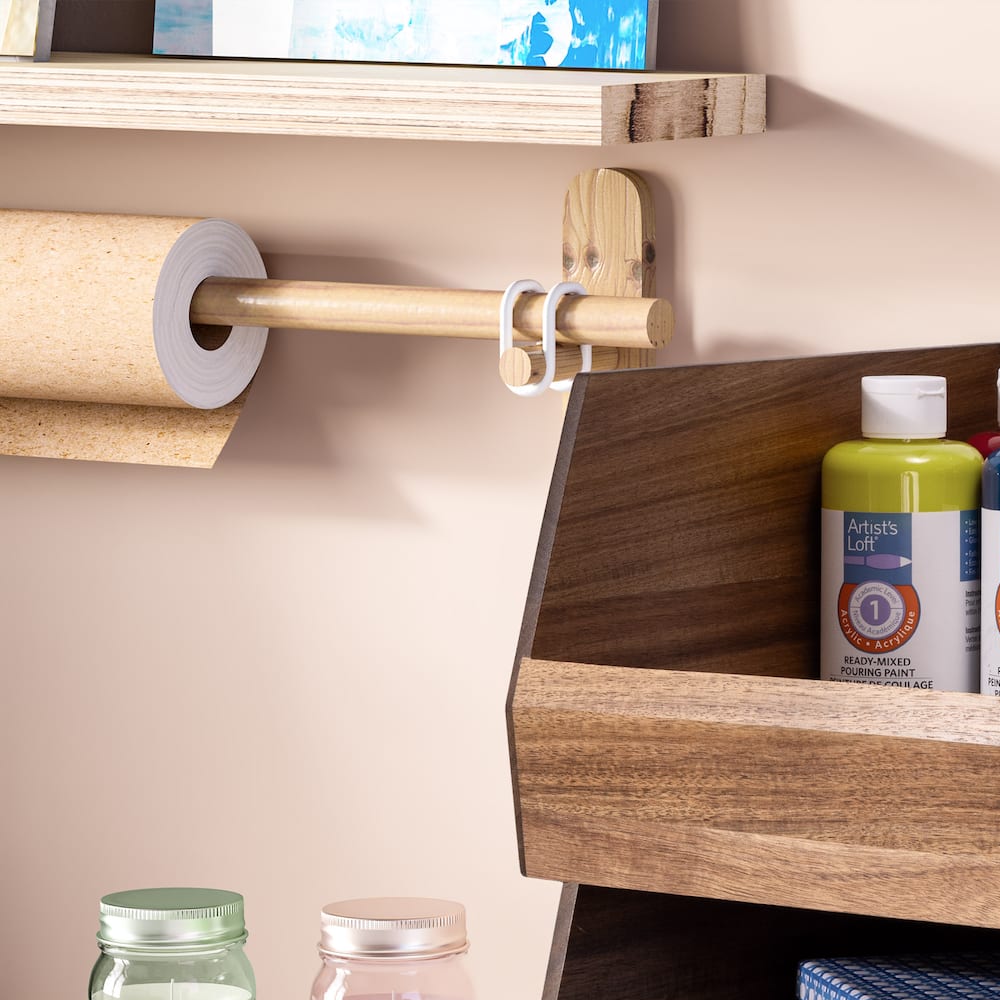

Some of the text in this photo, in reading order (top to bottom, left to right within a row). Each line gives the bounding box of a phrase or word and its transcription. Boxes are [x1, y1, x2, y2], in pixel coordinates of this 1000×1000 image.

[847, 517, 898, 535] Artist's
[870, 600, 879, 620] 1
[840, 609, 916, 649] Acrylic Acrylique
[844, 656, 911, 667] READY-MIXED
[840, 666, 916, 677] POURING PAINT
